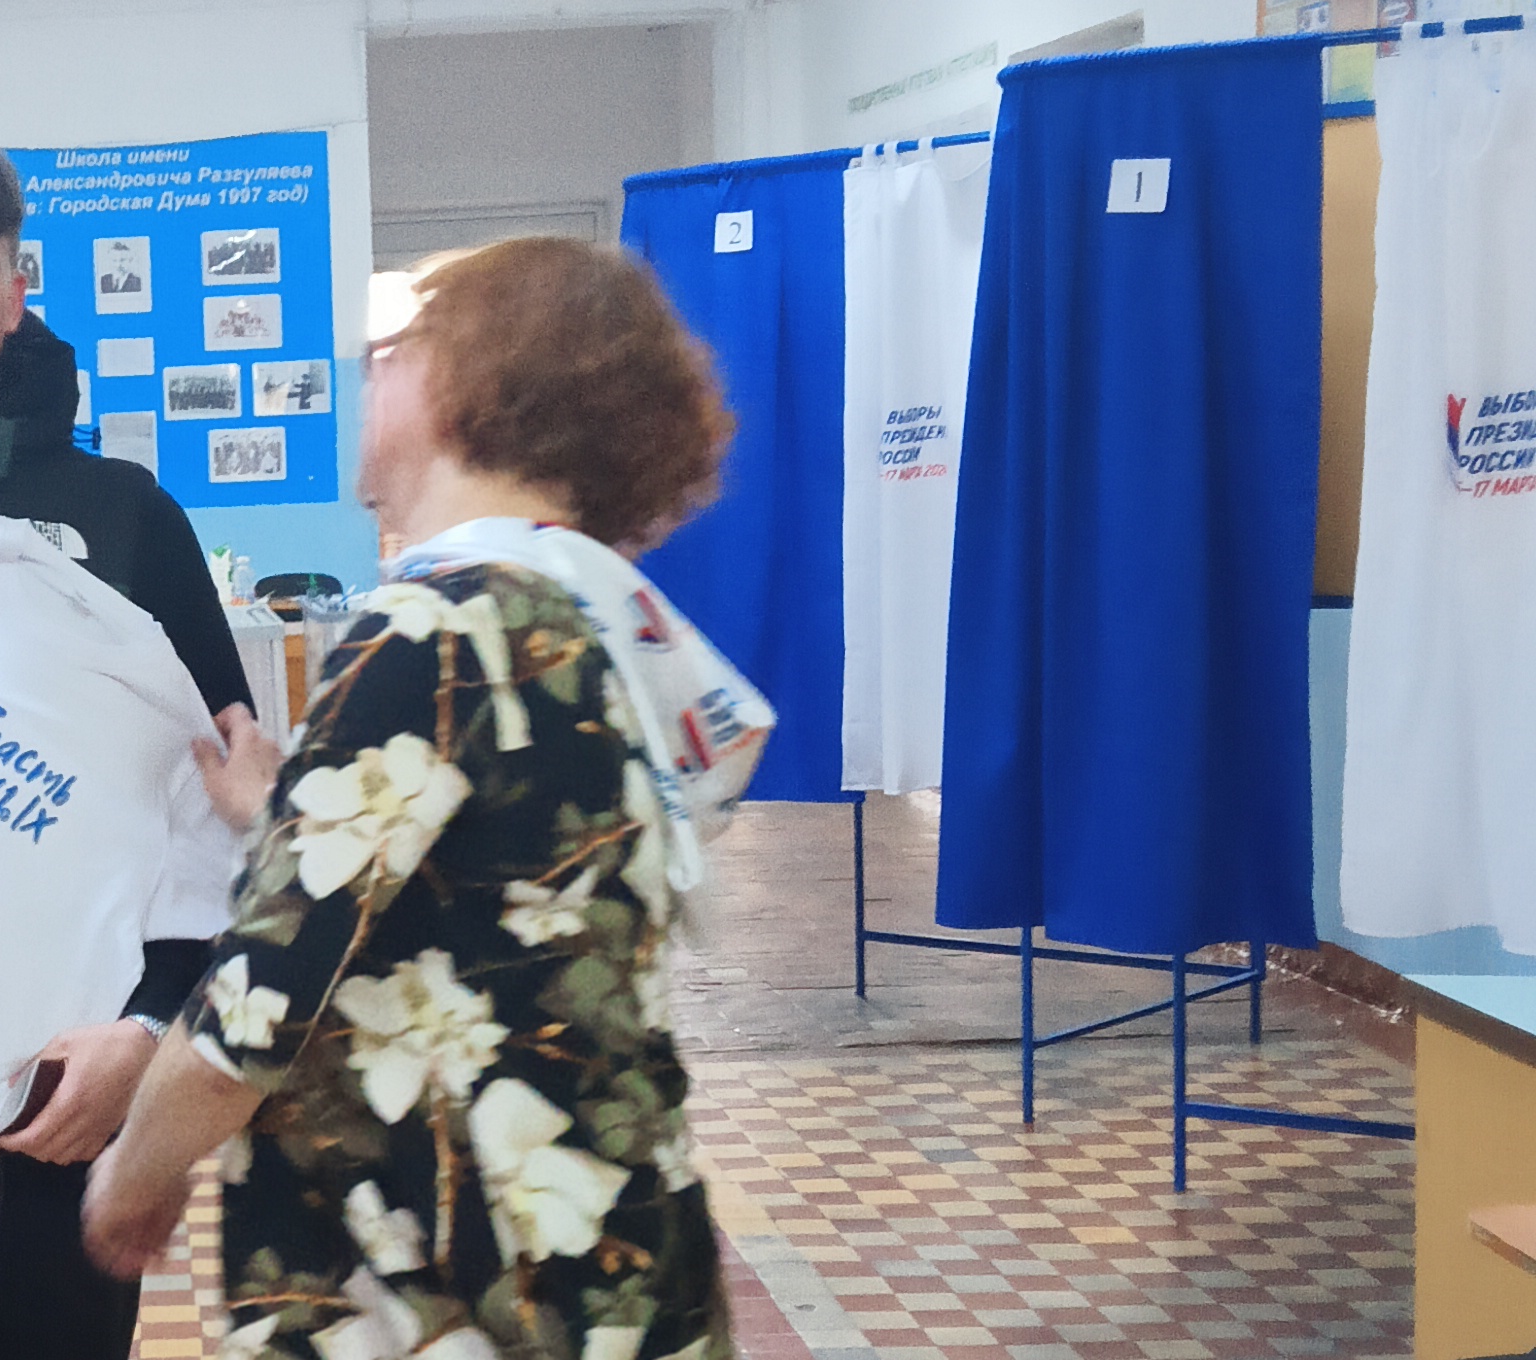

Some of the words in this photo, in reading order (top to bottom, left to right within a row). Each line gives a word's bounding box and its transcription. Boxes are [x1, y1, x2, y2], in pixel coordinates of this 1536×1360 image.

[56, 149, 122, 169] Школа
[127, 148, 190, 165] имени
[26, 170, 192, 193] Александровича
[48, 194, 154, 217] Городская
[157, 191, 211, 212] Дума
[729, 221, 742, 244] 2
